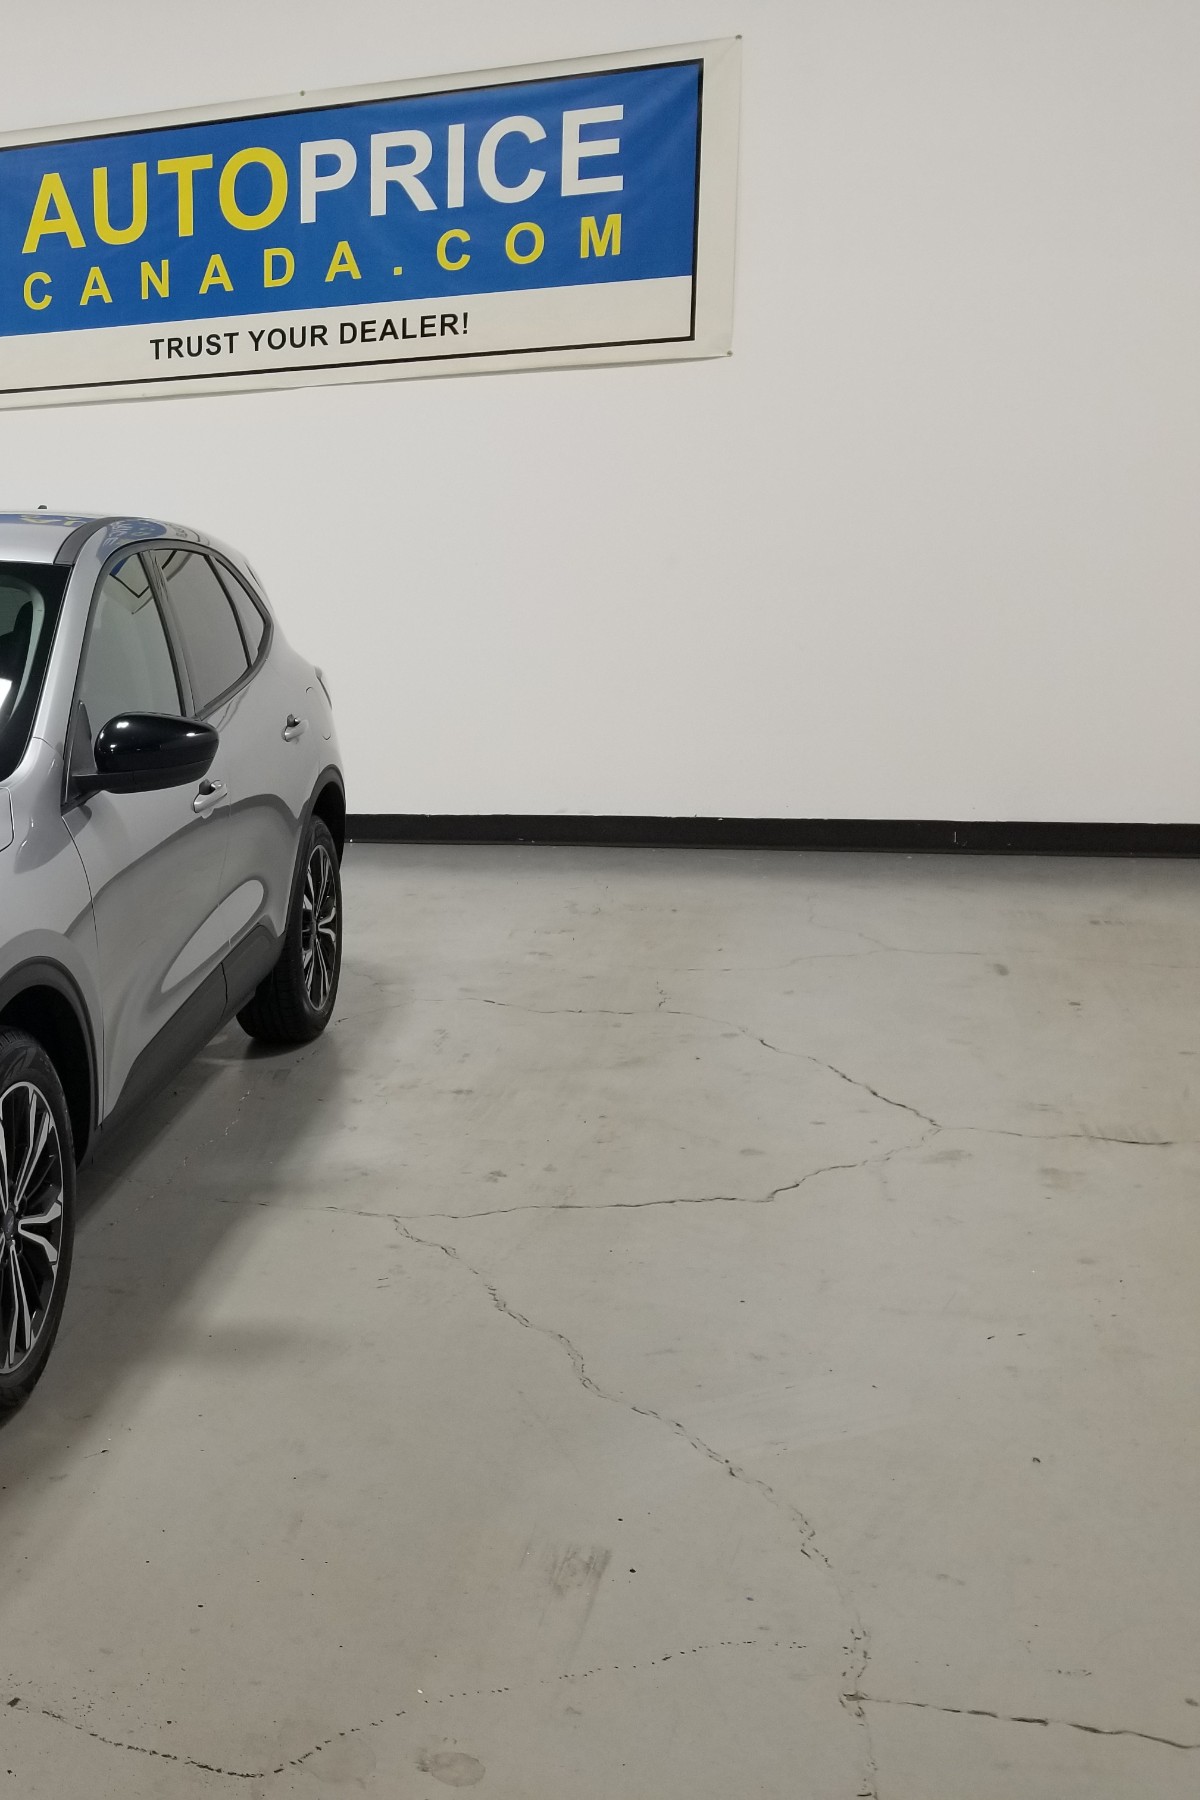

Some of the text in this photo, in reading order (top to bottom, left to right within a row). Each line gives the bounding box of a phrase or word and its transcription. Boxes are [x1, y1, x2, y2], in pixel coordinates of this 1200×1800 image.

[21, 104, 624, 254] AUTOPRICE
[23, 213, 622, 311] CANADA.COM
[149, 311, 469, 360] TRUST YOUR DEALER!
